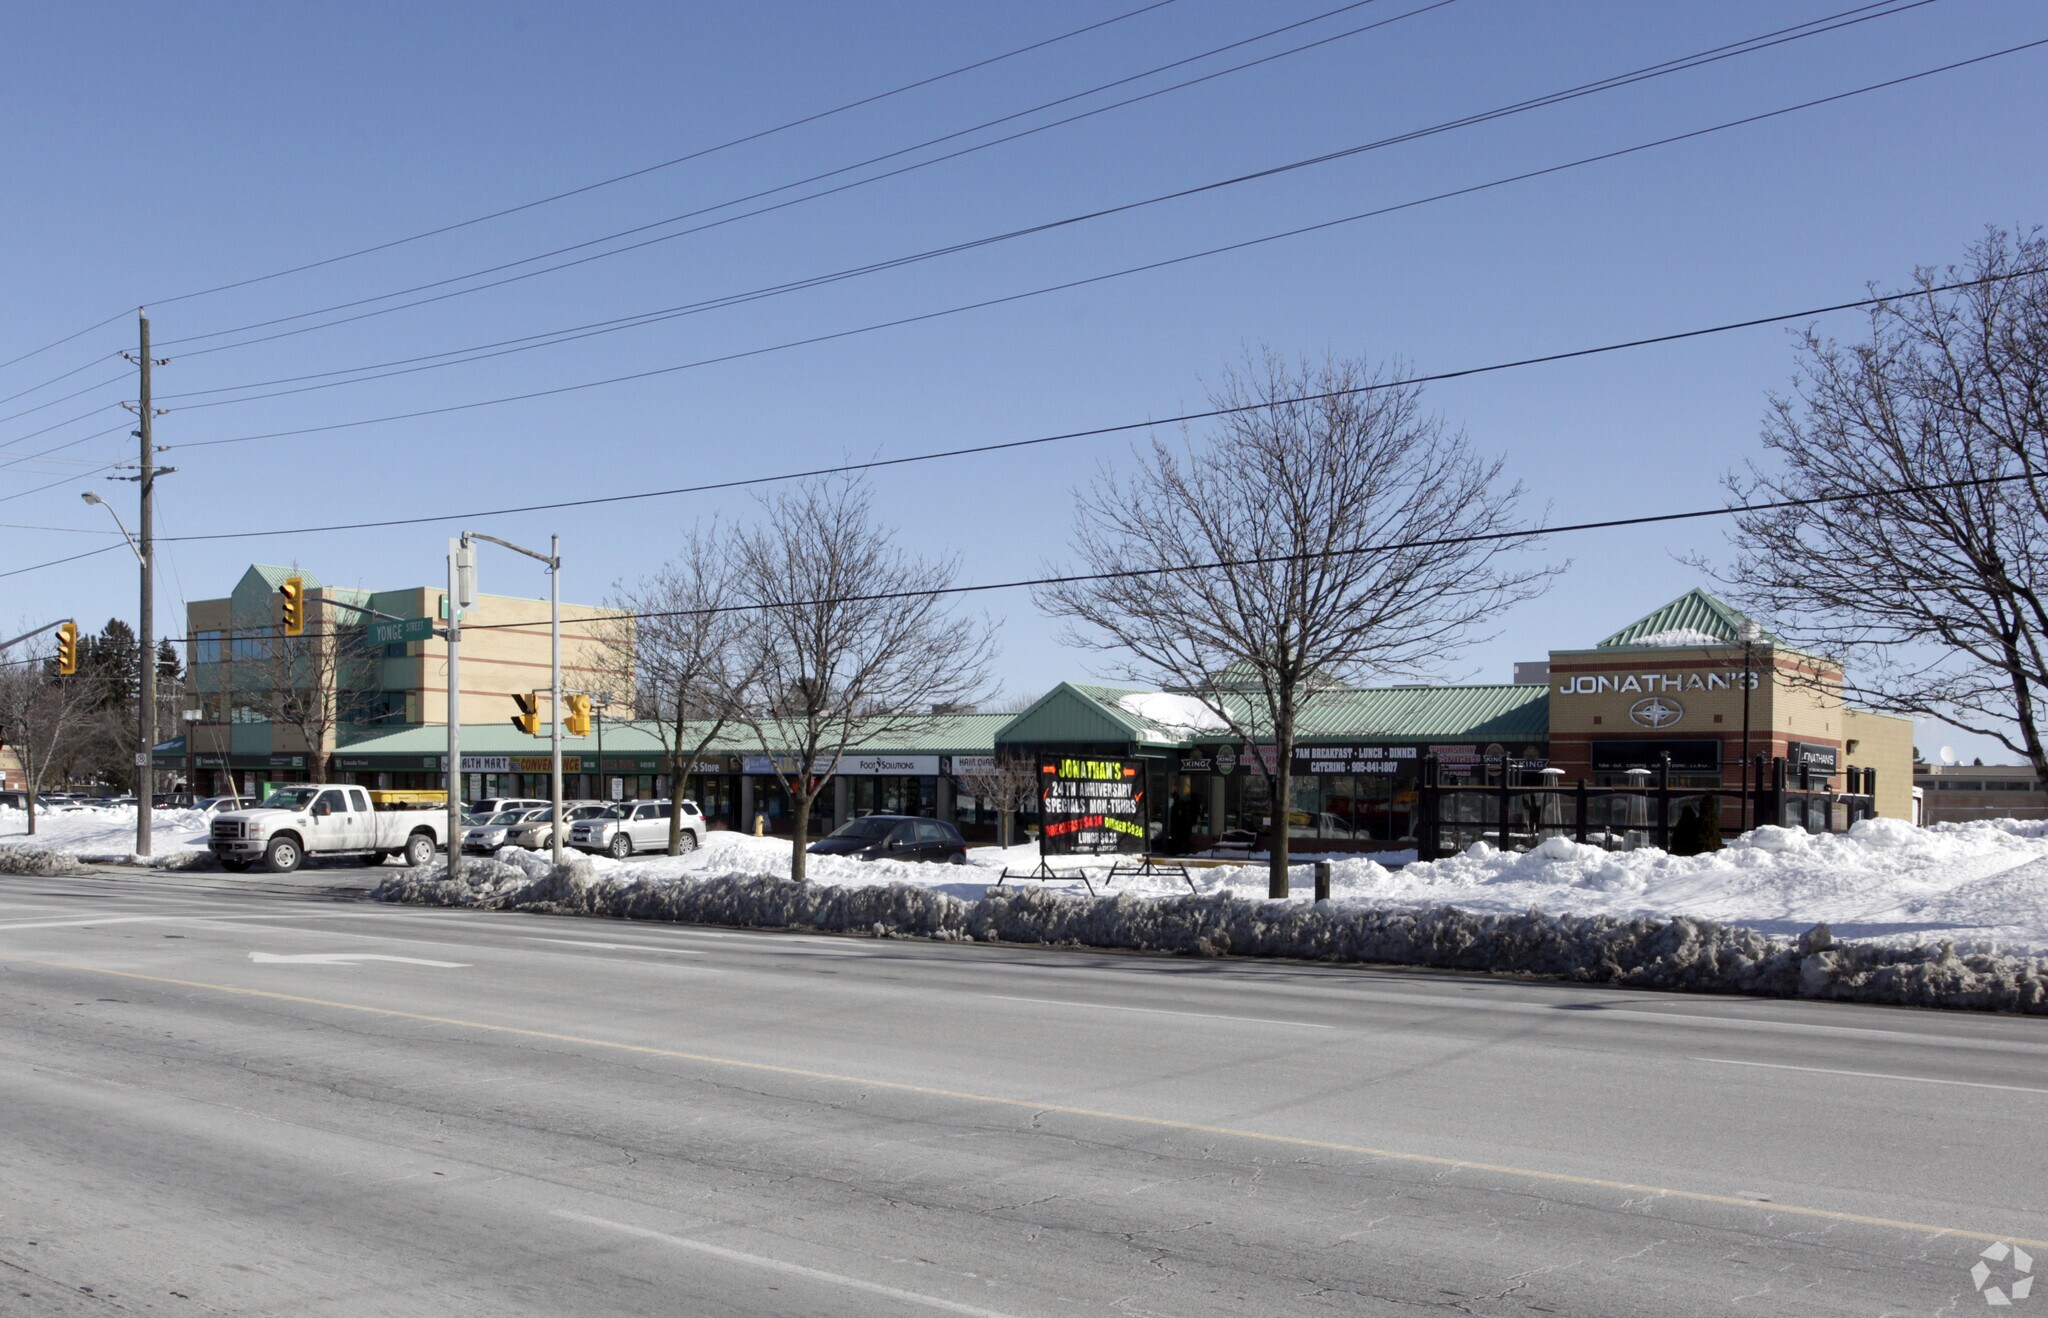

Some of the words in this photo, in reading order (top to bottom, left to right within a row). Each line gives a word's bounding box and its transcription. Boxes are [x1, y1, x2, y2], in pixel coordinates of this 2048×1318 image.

[377, 624, 403, 640] YONGE
[406, 621, 424, 632] STREET
[1560, 671, 1759, 694] JONATHAN'S
[1295, 747, 1310, 759] 7AM
[1311, 747, 1353, 759] BREAKFAST
[1359, 747, 1383, 759] LUNCH
[1389, 747, 1417, 759] DINNER
[484, 757, 507, 769] MART
[700, 761, 720, 773] Store
[1311, 761, 1346, 773] CATERING
[1351, 761, 1398, 773] 905-841-1807
[1519, 760, 1544, 768] KING
[1059, 759, 1121, 780] JONATHAN'S
[1080, 782, 1132, 797] ANNIVERSARY
[1045, 798, 1086, 813] SPECIALS
[1089, 800, 1137, 813] MON-THURS
[1078, 832, 1099, 844] LUNCH
